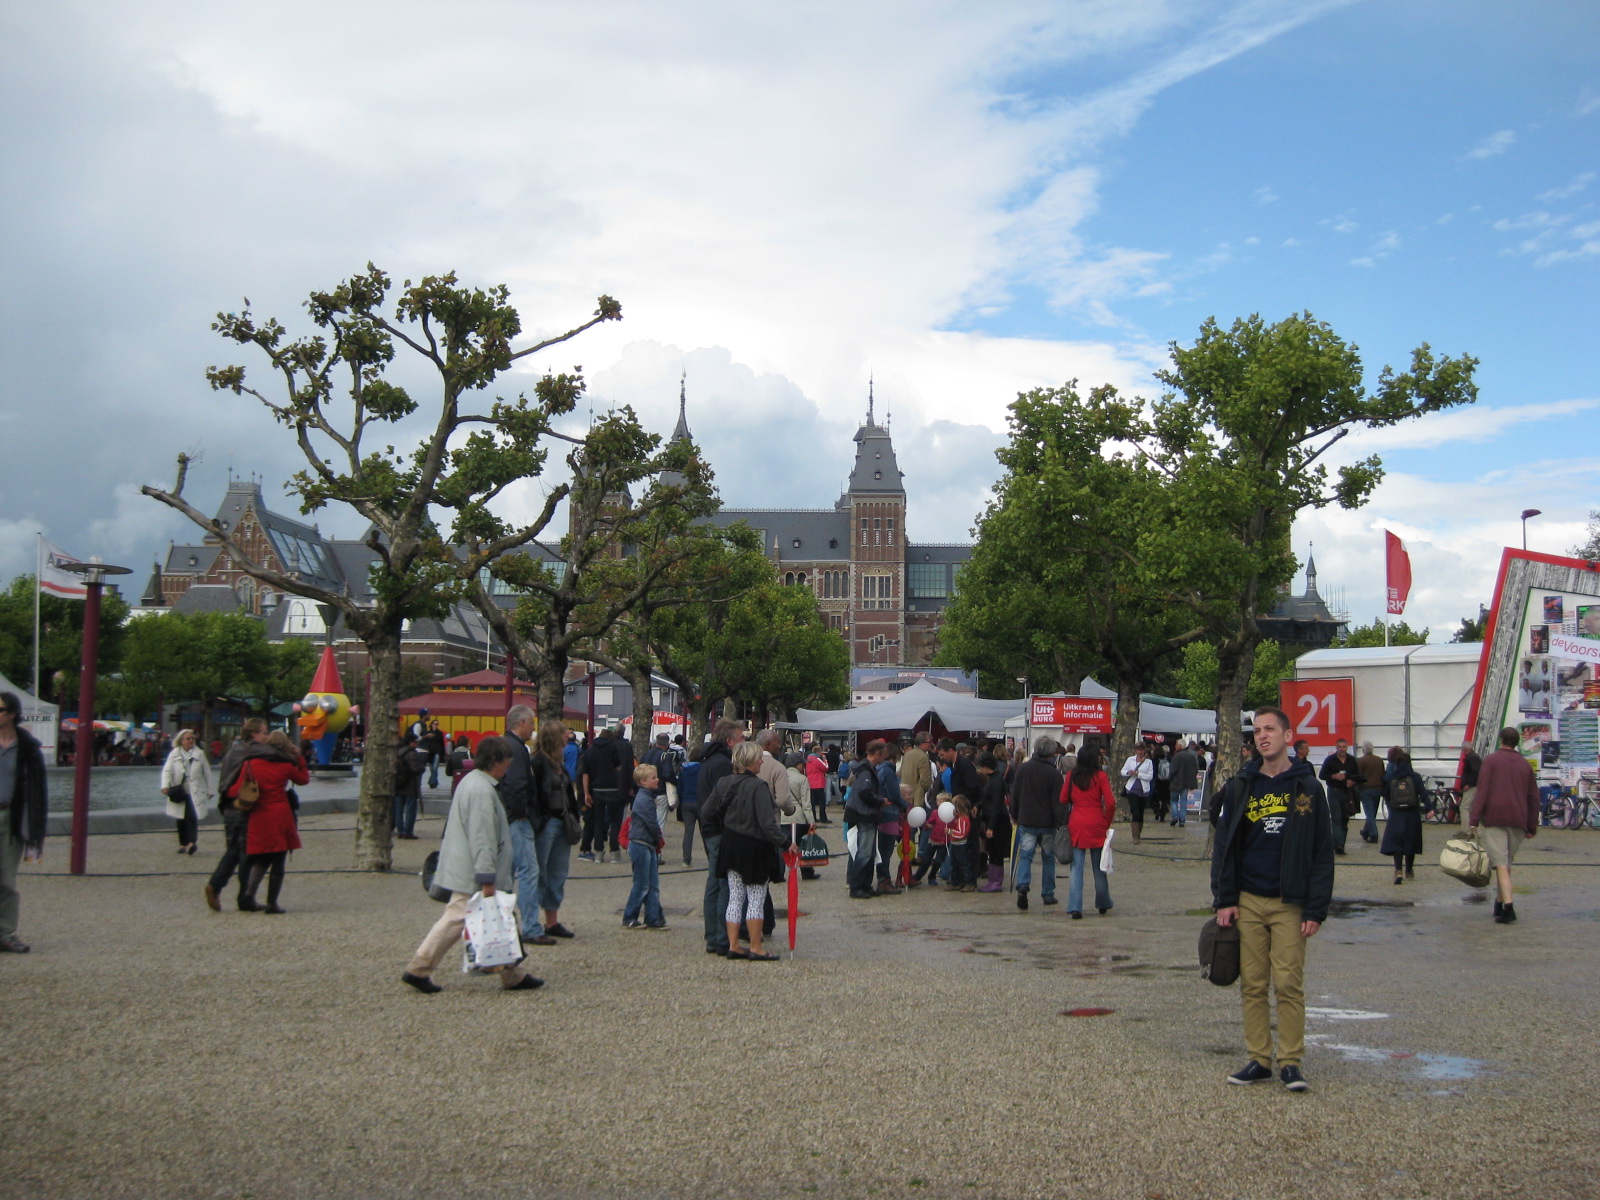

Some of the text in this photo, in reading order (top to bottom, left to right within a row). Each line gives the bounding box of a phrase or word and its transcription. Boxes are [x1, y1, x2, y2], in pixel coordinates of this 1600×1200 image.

[1063, 703, 1095, 712] Uitkrant
[1063, 711, 1104, 719] Informatie
[1296, 694, 1336, 734] 21
